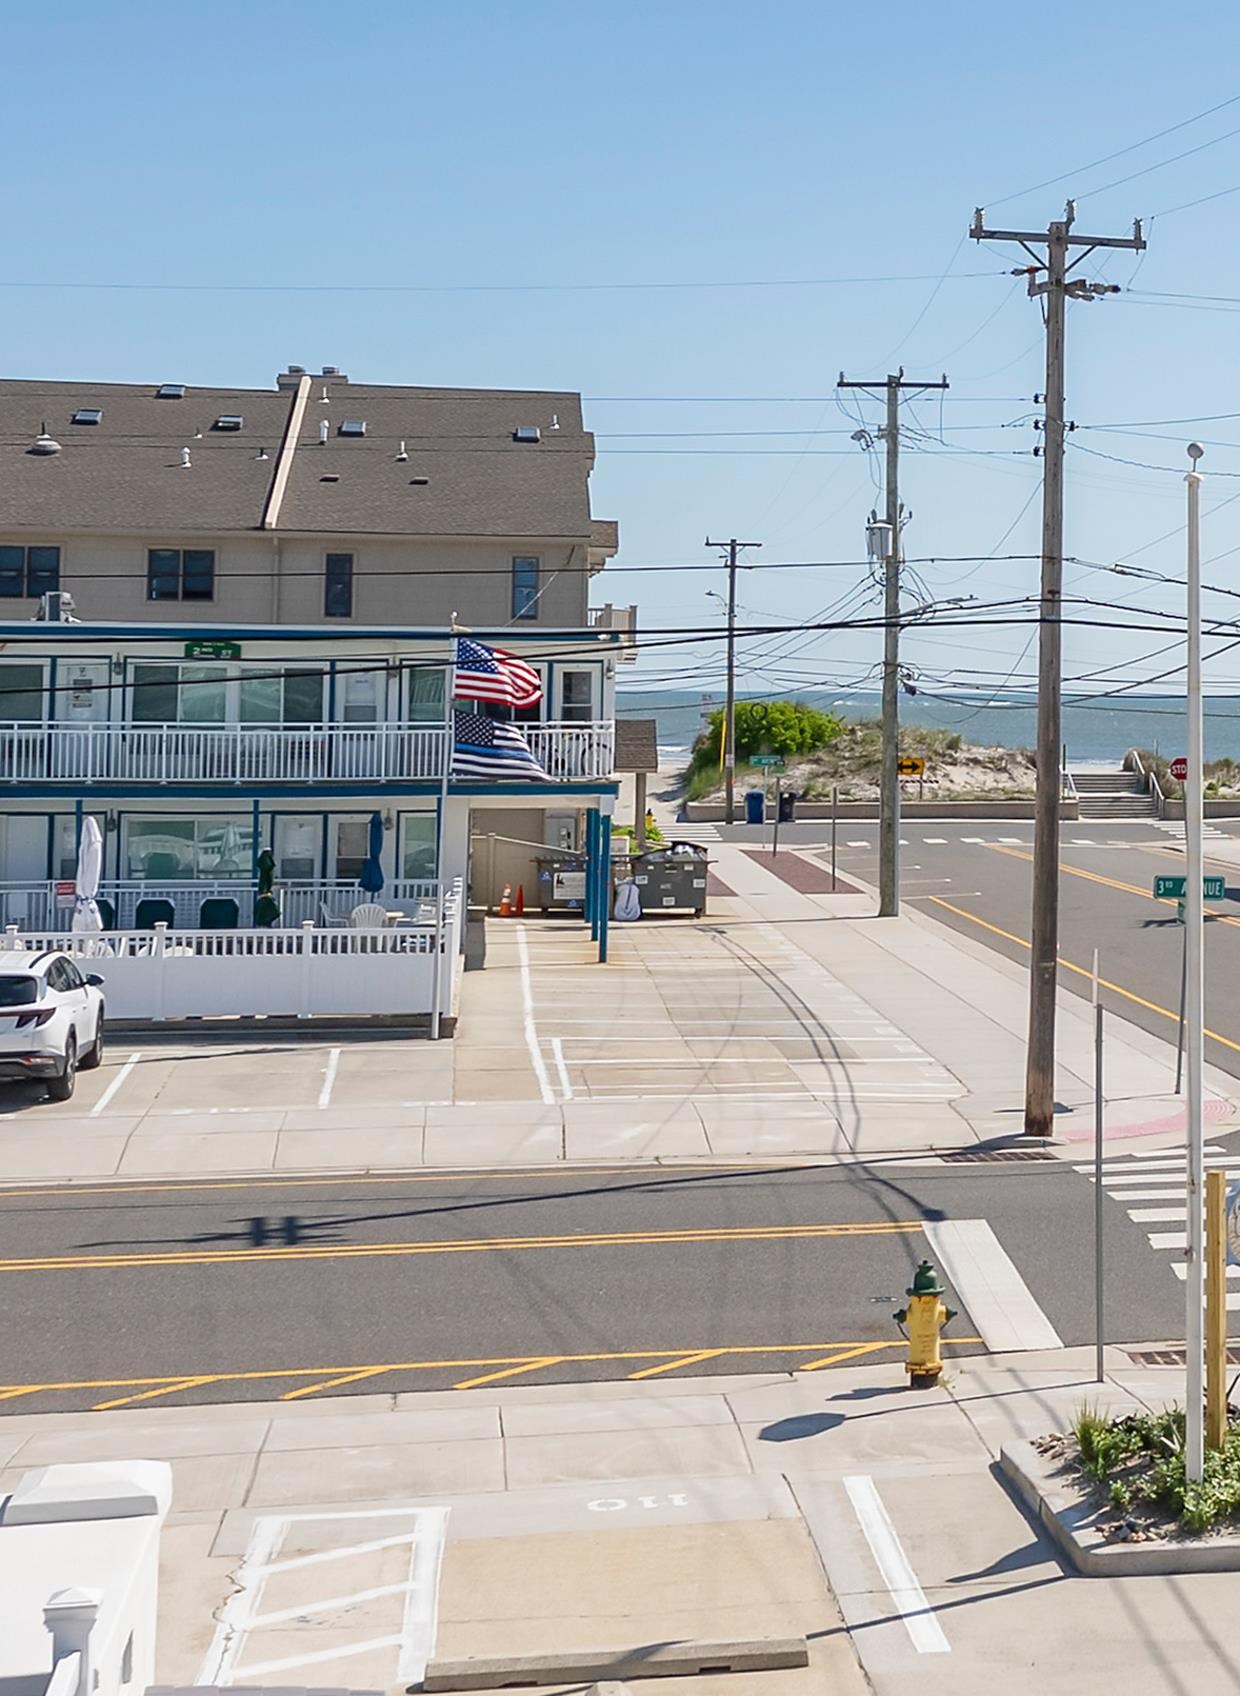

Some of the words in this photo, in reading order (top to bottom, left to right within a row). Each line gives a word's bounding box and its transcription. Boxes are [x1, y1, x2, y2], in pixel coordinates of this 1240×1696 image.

[1171, 765, 1187, 775] STO
[1158, 881, 1174, 894] 3RD
[1180, 881, 1220, 895] AUE
